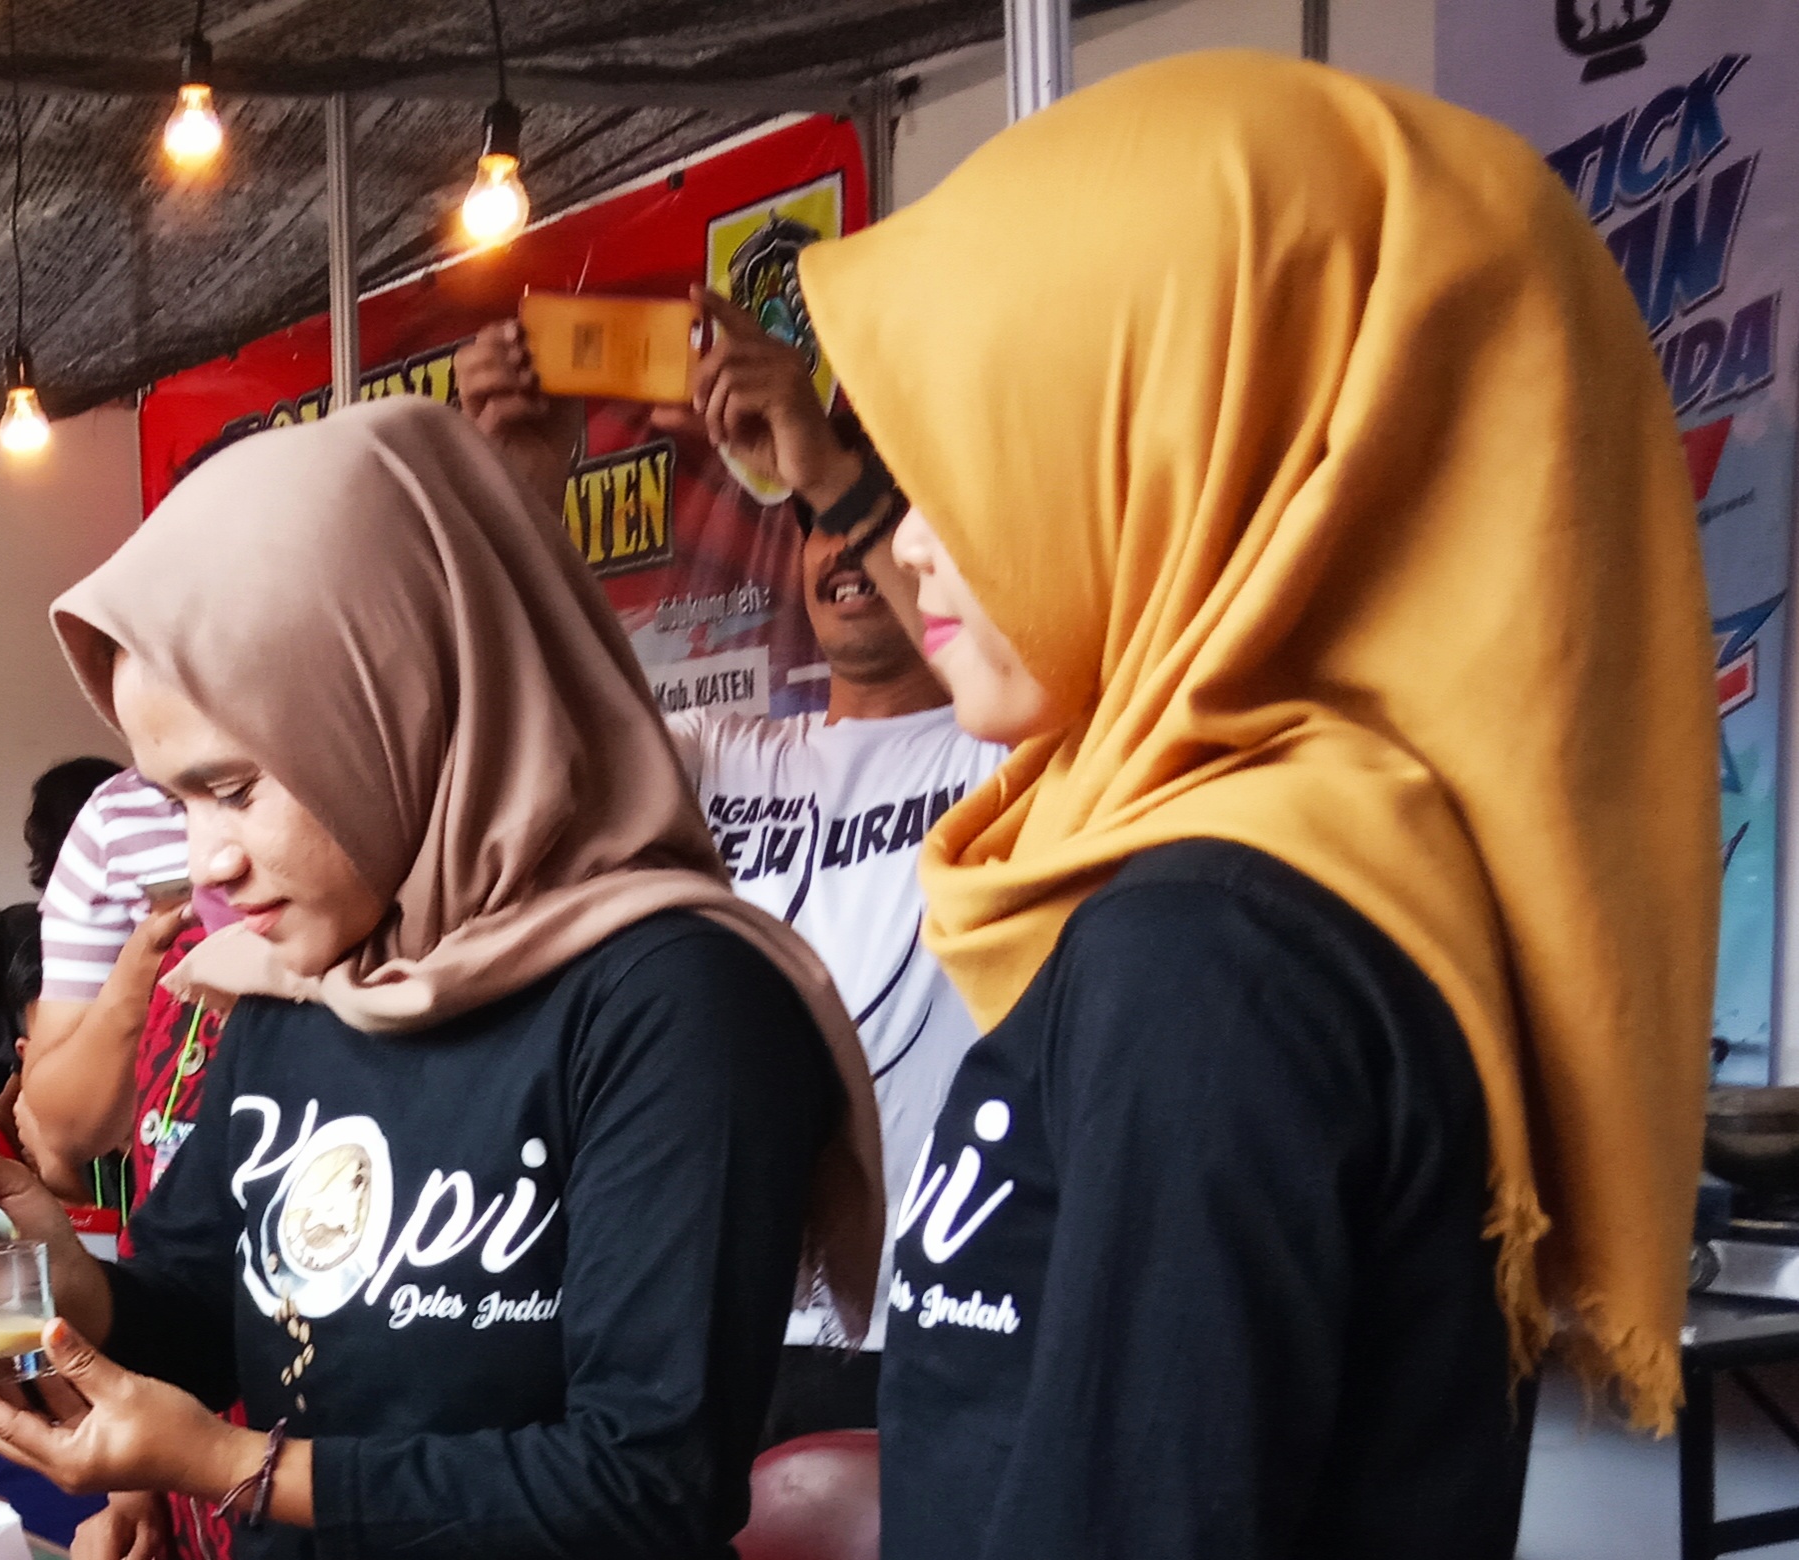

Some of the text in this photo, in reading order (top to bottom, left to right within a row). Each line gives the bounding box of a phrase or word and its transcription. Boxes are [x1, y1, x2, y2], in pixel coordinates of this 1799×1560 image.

[708, 793, 806, 827] AGAAH
[388, 1284, 467, 1330] Deles
[918, 1283, 1021, 1334] Indah
